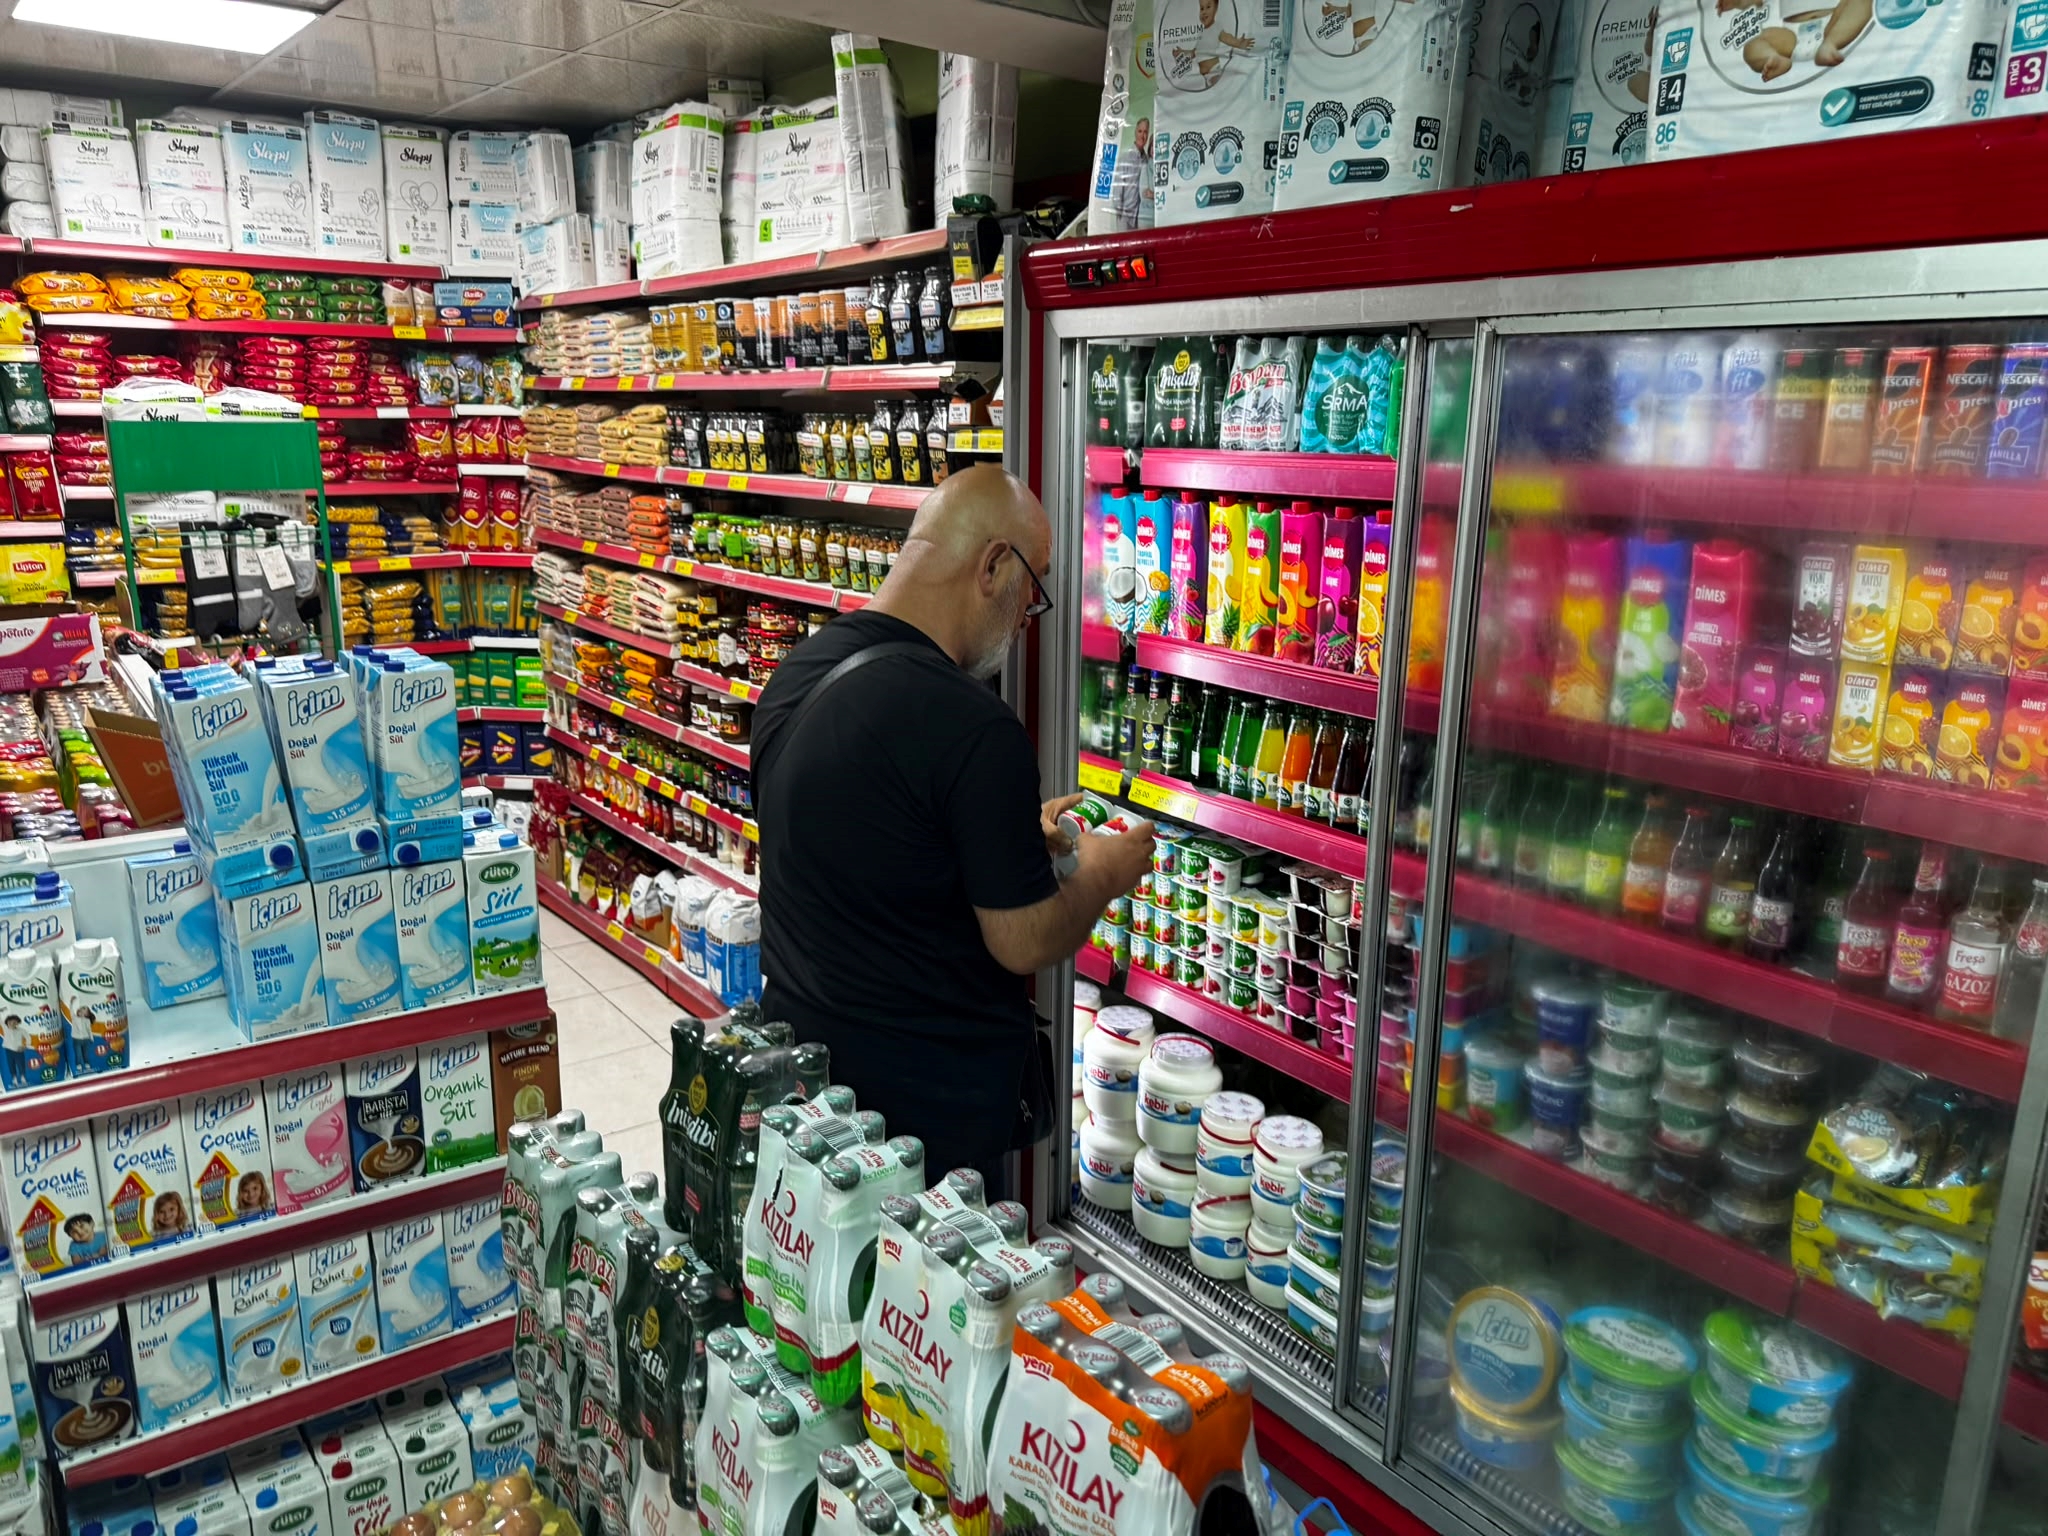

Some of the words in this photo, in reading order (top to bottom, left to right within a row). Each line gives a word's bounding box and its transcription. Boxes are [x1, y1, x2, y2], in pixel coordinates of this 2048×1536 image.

[1117, 1, 1135, 12] adult
[1113, 12, 1133, 23] pants
[1733, 8, 1755, 27] Anne
[1163, 24, 1205, 39] PREMIUM
[1723, 21, 1751, 46] Kucağı
[1750, 9, 1767, 26] gibi
[1735, 26, 1760, 47] Rahat
[1607, 61, 1631, 82] Kucağı
[1625, 56, 1643, 74] gibi
[1614, 53, 1633, 67] Anne
[1617, 68, 1637, 83] Rahat
[2009, 60, 2020, 86] midi
[2022, 57, 2042, 85] 3
[1667, 79, 1682, 103] 4
[1971, 88, 1990, 117] 86
[1421, 118, 1440, 129] extra
[1656, 121, 1676, 144] 86
[325, 130, 367, 152] Sleepy
[1288, 135, 1299, 153] 6
[247, 140, 291, 164] Sleepy
[399, 147, 433, 165] Sleepy
[1570, 150, 1584, 169] 5
[1278, 164, 1293, 180] 54
[1775, 402, 1806, 419] ICE
[1831, 403, 1865, 420] ICE
[1247, 536, 1265, 550] DİMES
[1283, 540, 1302, 554] DİMES
[1324, 545, 1344, 559] DİMES
[1364, 550, 1386, 565] DİMES
[1805, 561, 1833, 570] DİMES
[14, 561, 45, 573] Lipton
[1857, 563, 1889, 573] DİMES
[1923, 566, 1948, 577] DİMES
[1984, 569, 2009, 581] DİMES
[1861, 574, 1883, 587] KAYISI
[1695, 586, 1726, 604] DİMES
[1754, 662, 1774, 674] DİMES
[1800, 672, 1821, 685] DİMES
[1847, 676, 1877, 688] DİMES
[392, 676, 445, 714] İçim
[1849, 687, 1870, 701] KAYISI
[1904, 683, 1928, 694] DİMES
[1961, 691, 1986, 704] DİMES
[287, 685, 341, 727] İçim
[2022, 698, 2047, 712] DİMES
[192, 697, 244, 741] İçim
[388, 723, 417, 735] Doğal
[287, 735, 318, 750] Doğal
[390, 735, 404, 744] Süt
[201, 751, 241, 770] Yüksek
[290, 749, 306, 759] Süt
[204, 762, 249, 781] Proteinli
[209, 780, 227, 792] Süt
[484, 866, 515, 880] sütaş
[146, 864, 199, 905] İçim
[403, 867, 451, 908] İçim
[328, 879, 379, 921] İçim
[482, 883, 523, 915] Süt
[144, 911, 174, 925] Doğal
[250, 892, 298, 932] İçim
[146, 925, 161, 936] Süt
[400, 915, 427, 928] Doğal
[325, 929, 355, 942] Doğal
[401, 927, 415, 938] Süt
[1846, 924, 1879, 941] Freşa
[251, 944, 288, 959] Yüksek
[327, 941, 342, 952] Süt
[253, 953, 295, 971] Proteinli
[1955, 950, 1986, 964] Freşa
[254, 970, 271, 982] Süt
[1945, 973, 1992, 995] GAZOZ
[430, 1041, 477, 1081] İçim
[501, 1048, 527, 1064] NATURE
[528, 1044, 550, 1054] BLEND
[359, 1054, 405, 1091] İçim
[277, 1070, 329, 1113] İçim
[424, 1074, 489, 1102] Organik
[195, 1087, 250, 1132] İçim
[1144, 1092, 1170, 1112] kebir
[440, 1100, 476, 1126] Süt
[107, 1104, 166, 1151] İçim
[273, 1118, 303, 1134] Doğal
[1846, 1116, 1895, 1137] Burger
[200, 1125, 259, 1154] Çocuk
[275, 1133, 290, 1144] Süt
[14, 1127, 76, 1178] İçim
[113, 1143, 175, 1172] Çocuk
[1088, 1157, 1114, 1175] kebir
[21, 1167, 87, 1199] Çocuk
[1259, 1176, 1287, 1195] kebir
[384, 1215, 432, 1257] İçim
[761, 1197, 815, 1265] KIZILAY
[450, 1240, 476, 1255] Doğal
[883, 1238, 902, 1254] yeni
[309, 1239, 354, 1278] İçim
[451, 1254, 464, 1264] Süt
[382, 1260, 408, 1277] Doğal
[1013, 1265, 1049, 1290] 6x200ml
[231, 1258, 278, 1299] İçim
[311, 1268, 345, 1295] Rahat
[382, 1275, 396, 1285] Süt
[141, 1284, 195, 1329] İçim
[233, 1288, 269, 1316] Rahat
[49, 1311, 102, 1356] İçim
[1474, 1306, 1530, 1351] İçim
[137, 1333, 168, 1351] Doğal
[879, 1298, 953, 1384] KIZILAY
[1022, 1355, 1053, 1377] yeni
[711, 1424, 754, 1503] KIZILAY
[1020, 1421, 1125, 1520] KIZILAY
[423, 1468, 460, 1503] Süt
[1055, 1492, 1089, 1520] FRENK
